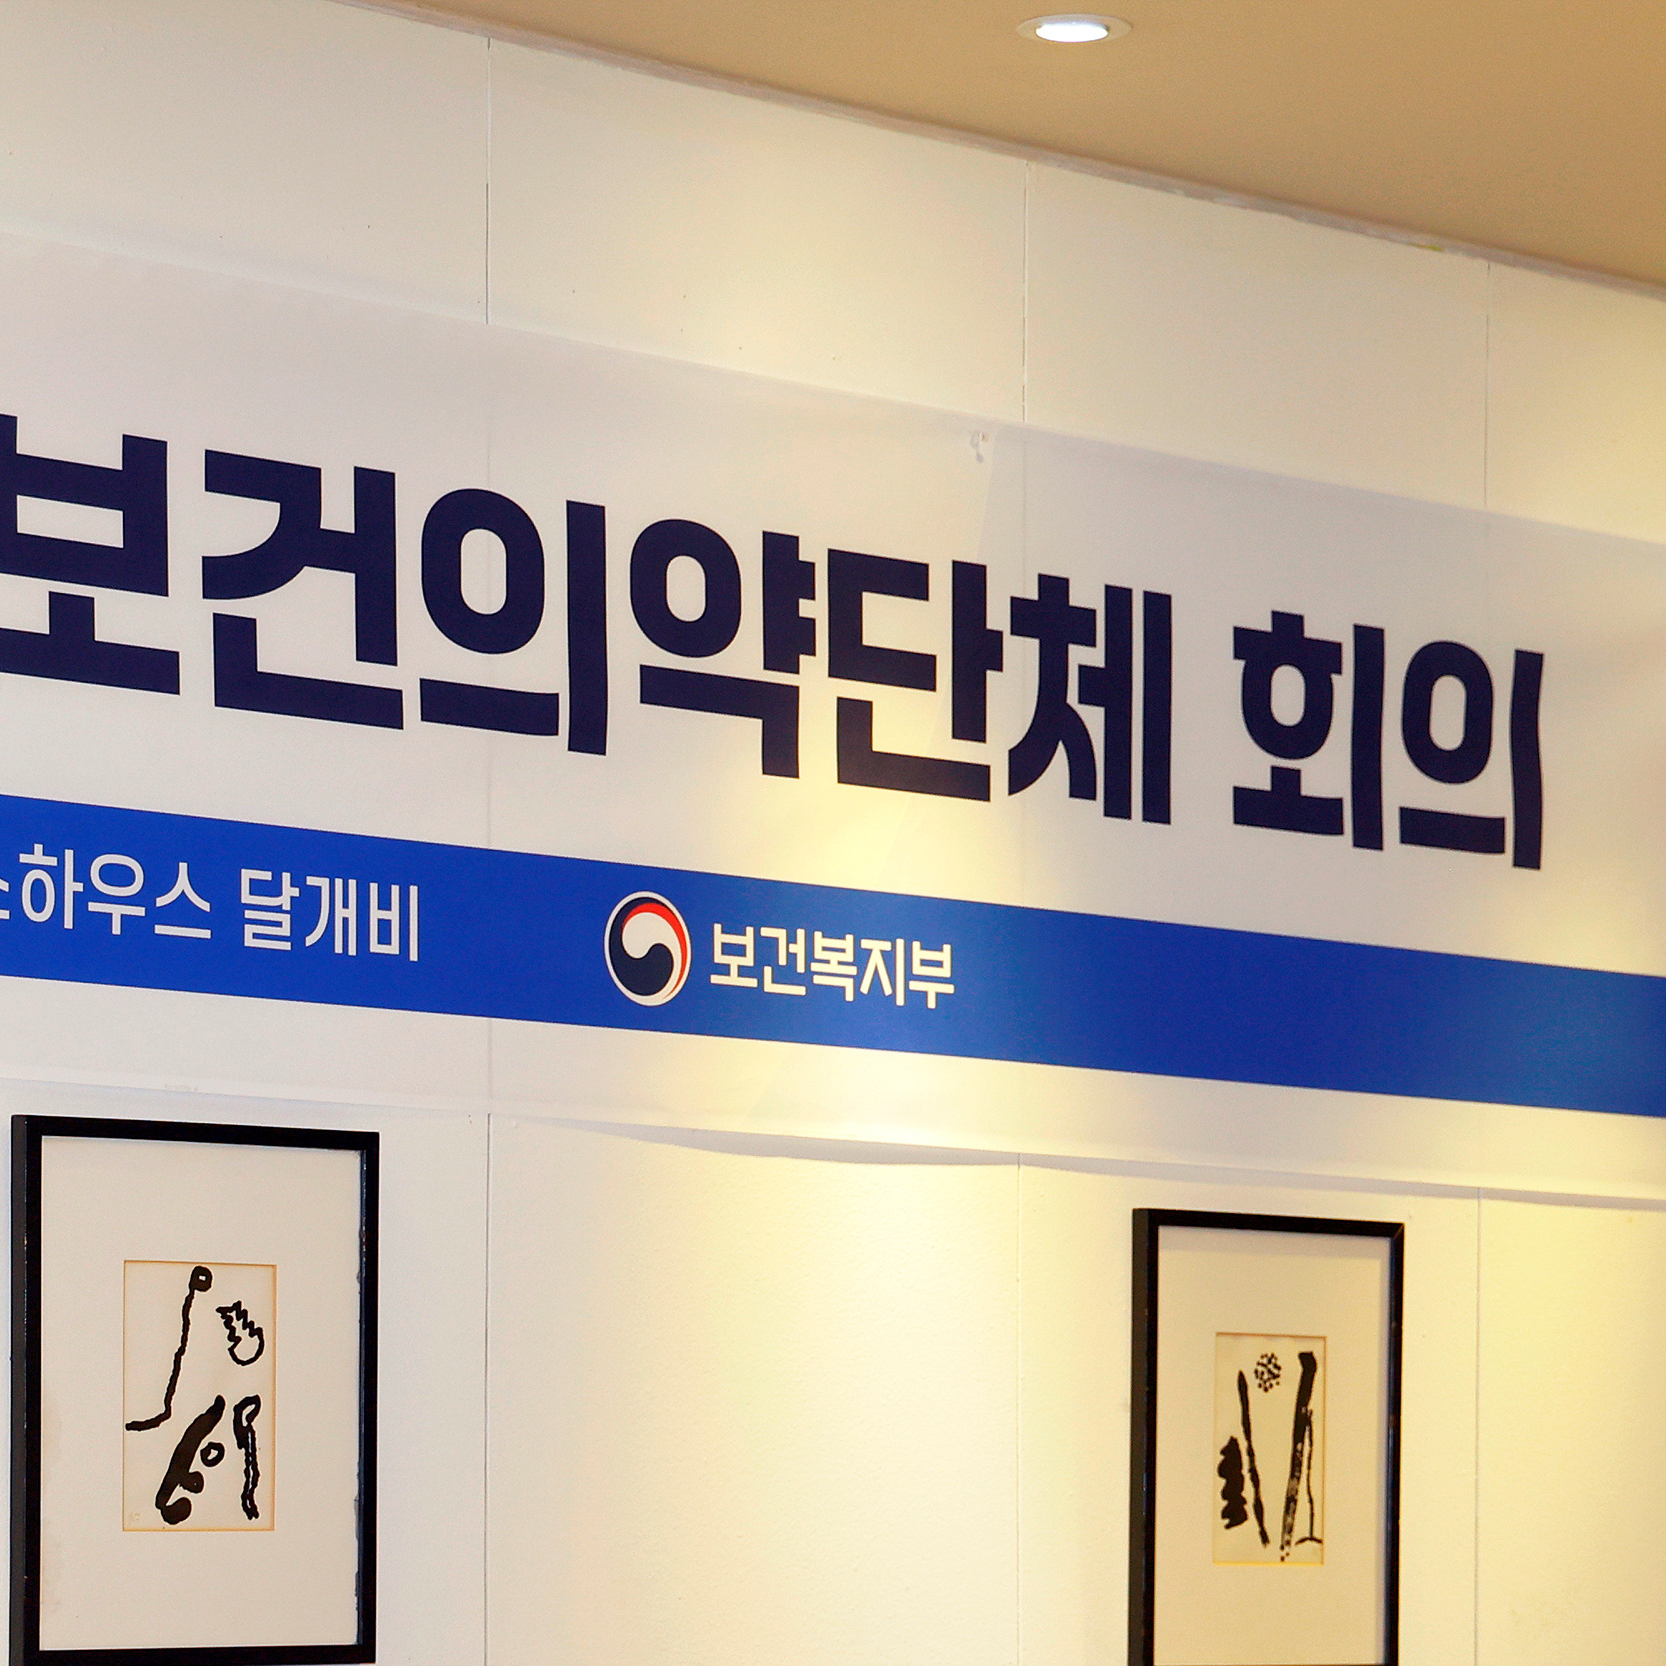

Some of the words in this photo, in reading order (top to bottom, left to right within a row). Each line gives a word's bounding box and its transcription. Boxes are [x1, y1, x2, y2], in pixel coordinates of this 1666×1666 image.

[1233, 611, 1544, 870] 회의
[241, 868, 418, 962] 달개비
[710, 923, 955, 1009] 보건복지부
